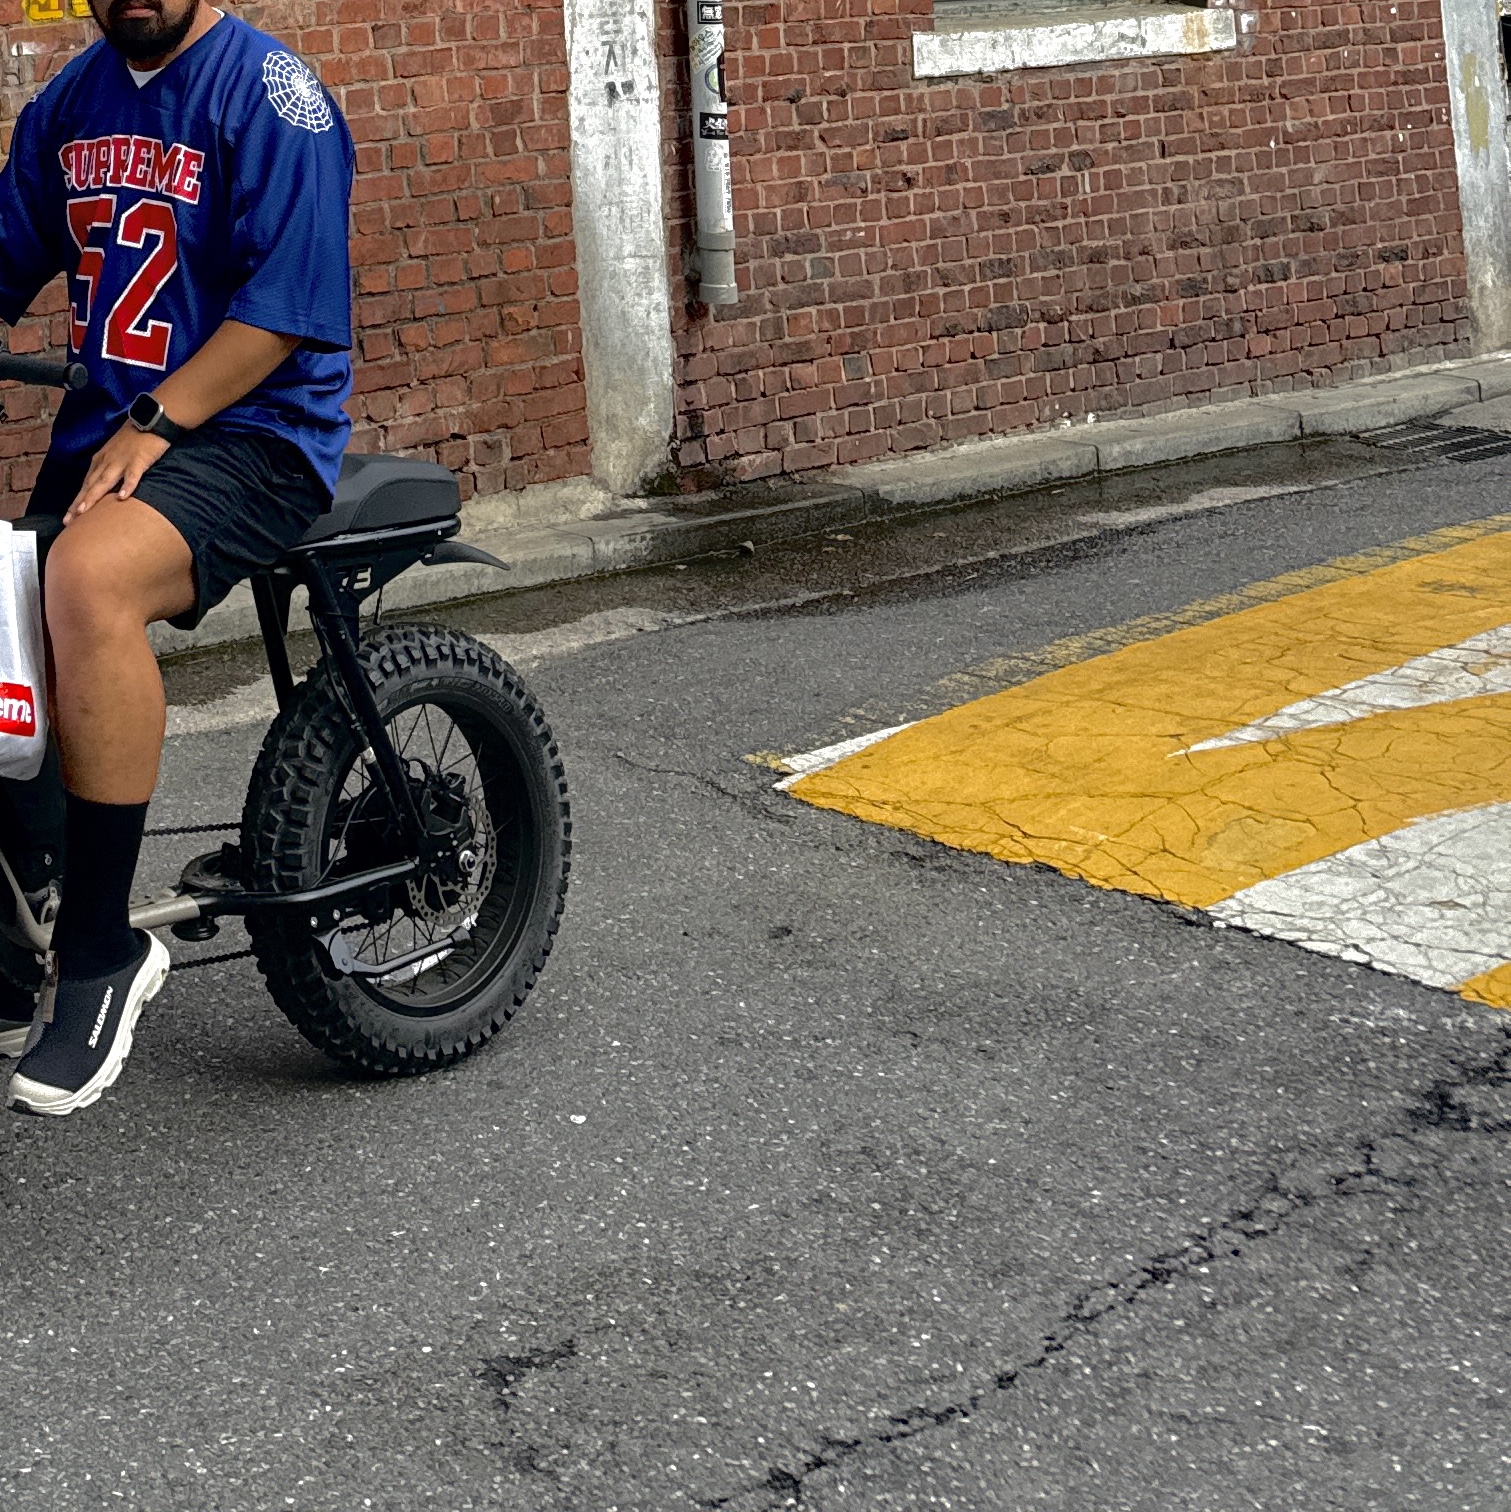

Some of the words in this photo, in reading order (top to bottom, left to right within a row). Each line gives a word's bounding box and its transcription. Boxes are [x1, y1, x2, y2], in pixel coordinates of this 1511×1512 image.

[58, 134, 205, 206] SUPREME
[66, 194, 178, 371] 52
[88, 985, 113, 1049] SALOMON
